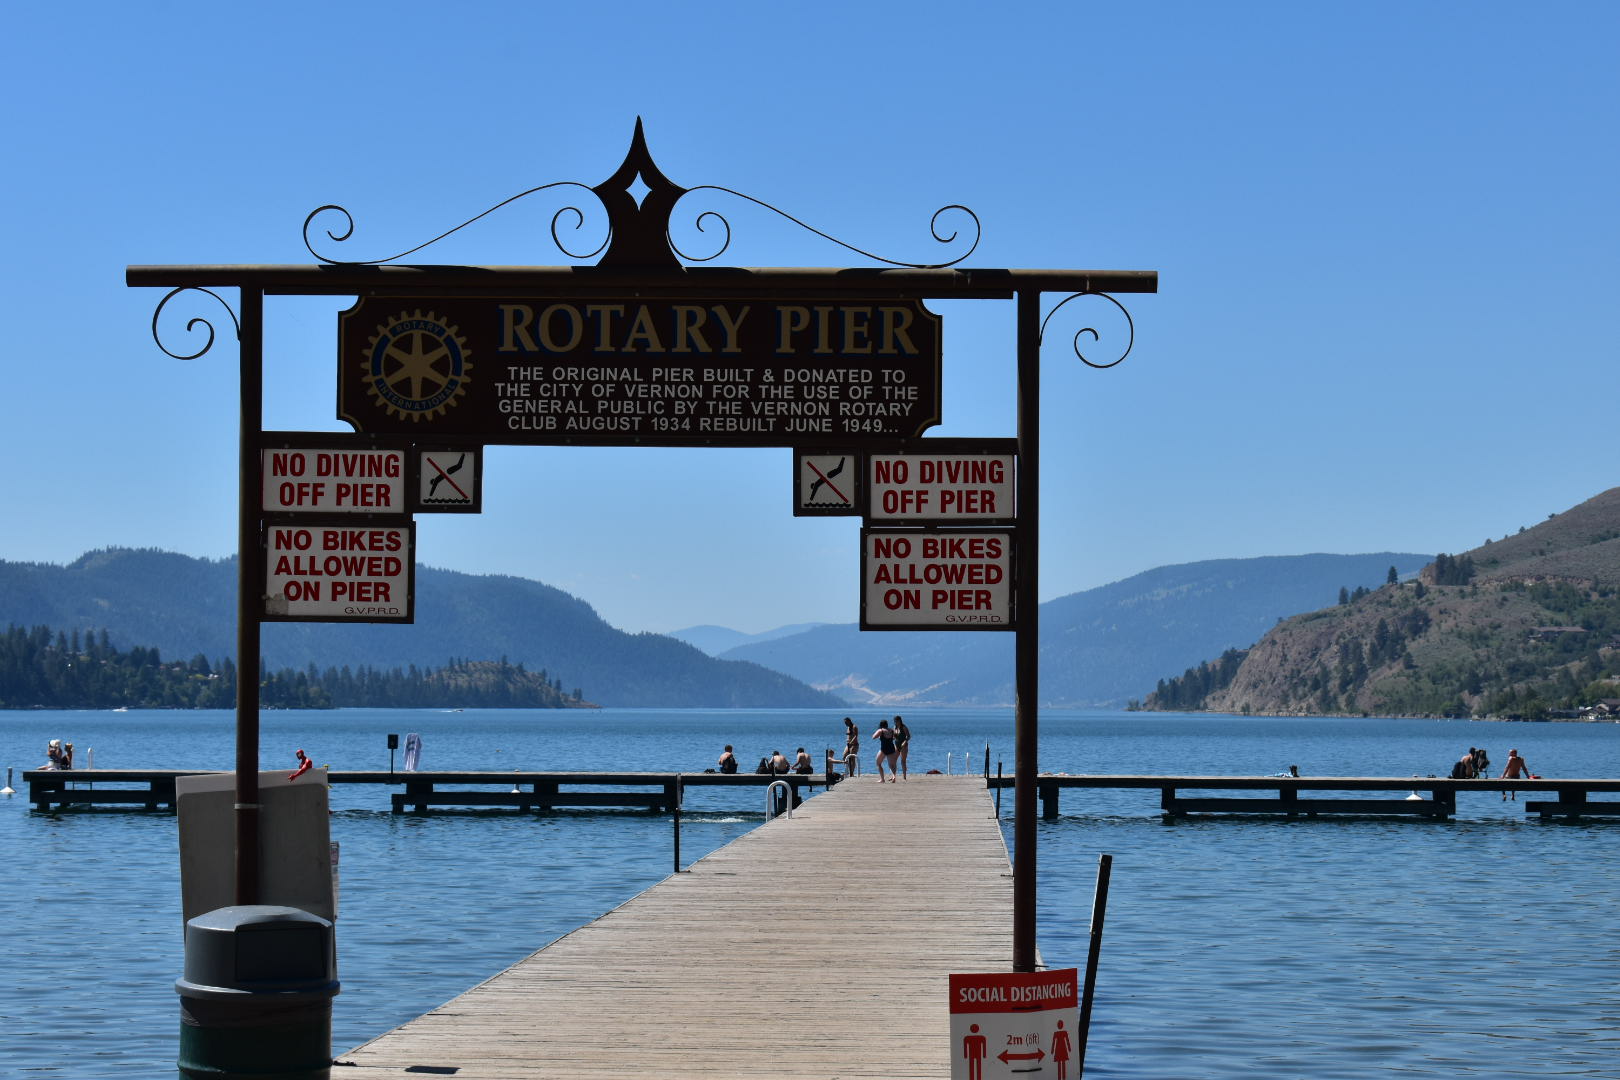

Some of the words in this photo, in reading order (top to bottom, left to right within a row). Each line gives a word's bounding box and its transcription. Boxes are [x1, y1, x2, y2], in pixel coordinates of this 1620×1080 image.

[396, 321, 440, 334] ROTARY
[498, 303, 750, 353] ROTARY
[776, 305, 919, 354] PIER
[507, 366, 544, 381] THE
[552, 367, 643, 381] ORIGINAL
[652, 368, 694, 382] PIER
[703, 368, 754, 382] BUILT
[763, 368, 775, 383] &
[784, 369, 873, 383] DONATED
[882, 369, 906, 383] TO
[379, 382, 456, 410] INTERNATIONAL
[495, 383, 531, 397] THE
[540, 383, 583, 397] CITY
[591, 384, 616, 398] OF
[626, 384, 703, 398] VERNON
[713, 385, 750, 399] FOR
[759, 385, 794, 399] THE
[803, 386, 840, 400] USE
[848, 386, 873, 400] OF
[882, 386, 918, 400] THE
[498, 400, 589, 414] GENERAL
[598, 400, 665, 415] PUBLIC
[674, 401, 698, 415] BY
[706, 401, 742, 415] THE
[751, 402, 831, 416] VERNON
[840, 402, 913, 417] ROTARY
[508, 416, 557, 430] CLUB
[566, 416, 642, 430] AUGUST
[651, 417, 691, 431] 1934
[700, 418, 776, 432] REBUILT
[785, 418, 833, 432] JUNE
[842, 419, 899, 433] 1949...
[272, 453, 305, 477] NO
[316, 454, 400, 478] DIVING
[875, 460, 908, 484] NO
[919, 460, 1004, 485] DIVING
[279, 482, 325, 506] OFF
[336, 483, 391, 507] PIER
[882, 490, 929, 514] OFF
[940, 490, 996, 514] PIER
[275, 530, 312, 550] NO
[323, 531, 402, 551] BIKES
[874, 538, 911, 559] NO
[922, 538, 1002, 559] BIKES
[274, 556, 402, 576] ALLOWED
[873, 564, 1003, 585] ALLOWED
[283, 580, 320, 601] ON
[331, 581, 391, 602] PIER
[883, 589, 921, 611] ON
[931, 590, 992, 611] PIER
[344, 607, 400, 615] G.V.P.R.D.
[945, 615, 1003, 623] G.V.P.R.D.
[959, 987, 1007, 1002] SOCIAL
[1010, 982, 1071, 1002] DISTANCING
[1006, 1035, 1023, 1045] 2m
[1025, 1033, 1040, 1047] (6ft)
